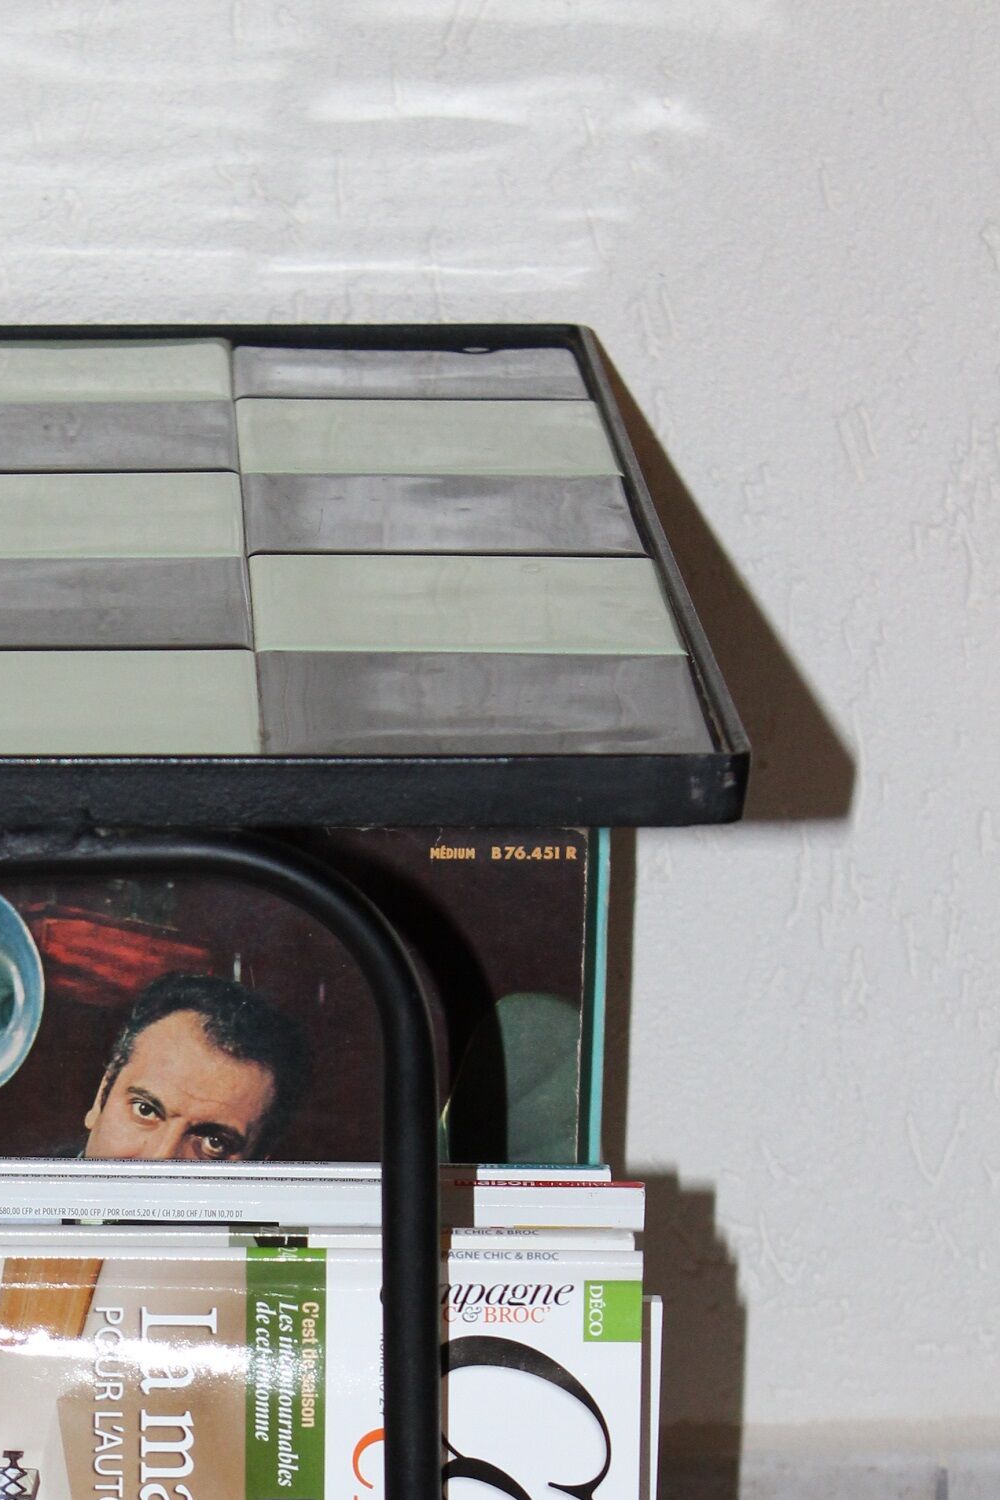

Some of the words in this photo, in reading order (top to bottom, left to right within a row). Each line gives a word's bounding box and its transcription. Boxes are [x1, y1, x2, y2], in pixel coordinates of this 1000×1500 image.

[430, 845, 475, 859] MÉDIUM
[565, 846, 577, 859] R
[483, 1251, 512, 1260] CHIC
[514, 1251, 524, 1260] &
[526, 1252, 560, 1261] BROC
[256, 1301, 278, 1324] de
[278, 1301, 299, 1332] Les
[301, 1301, 319, 1344] C'est
[588, 1284, 606, 1337] DÉCO
[140, 1305, 218, 1396] La
